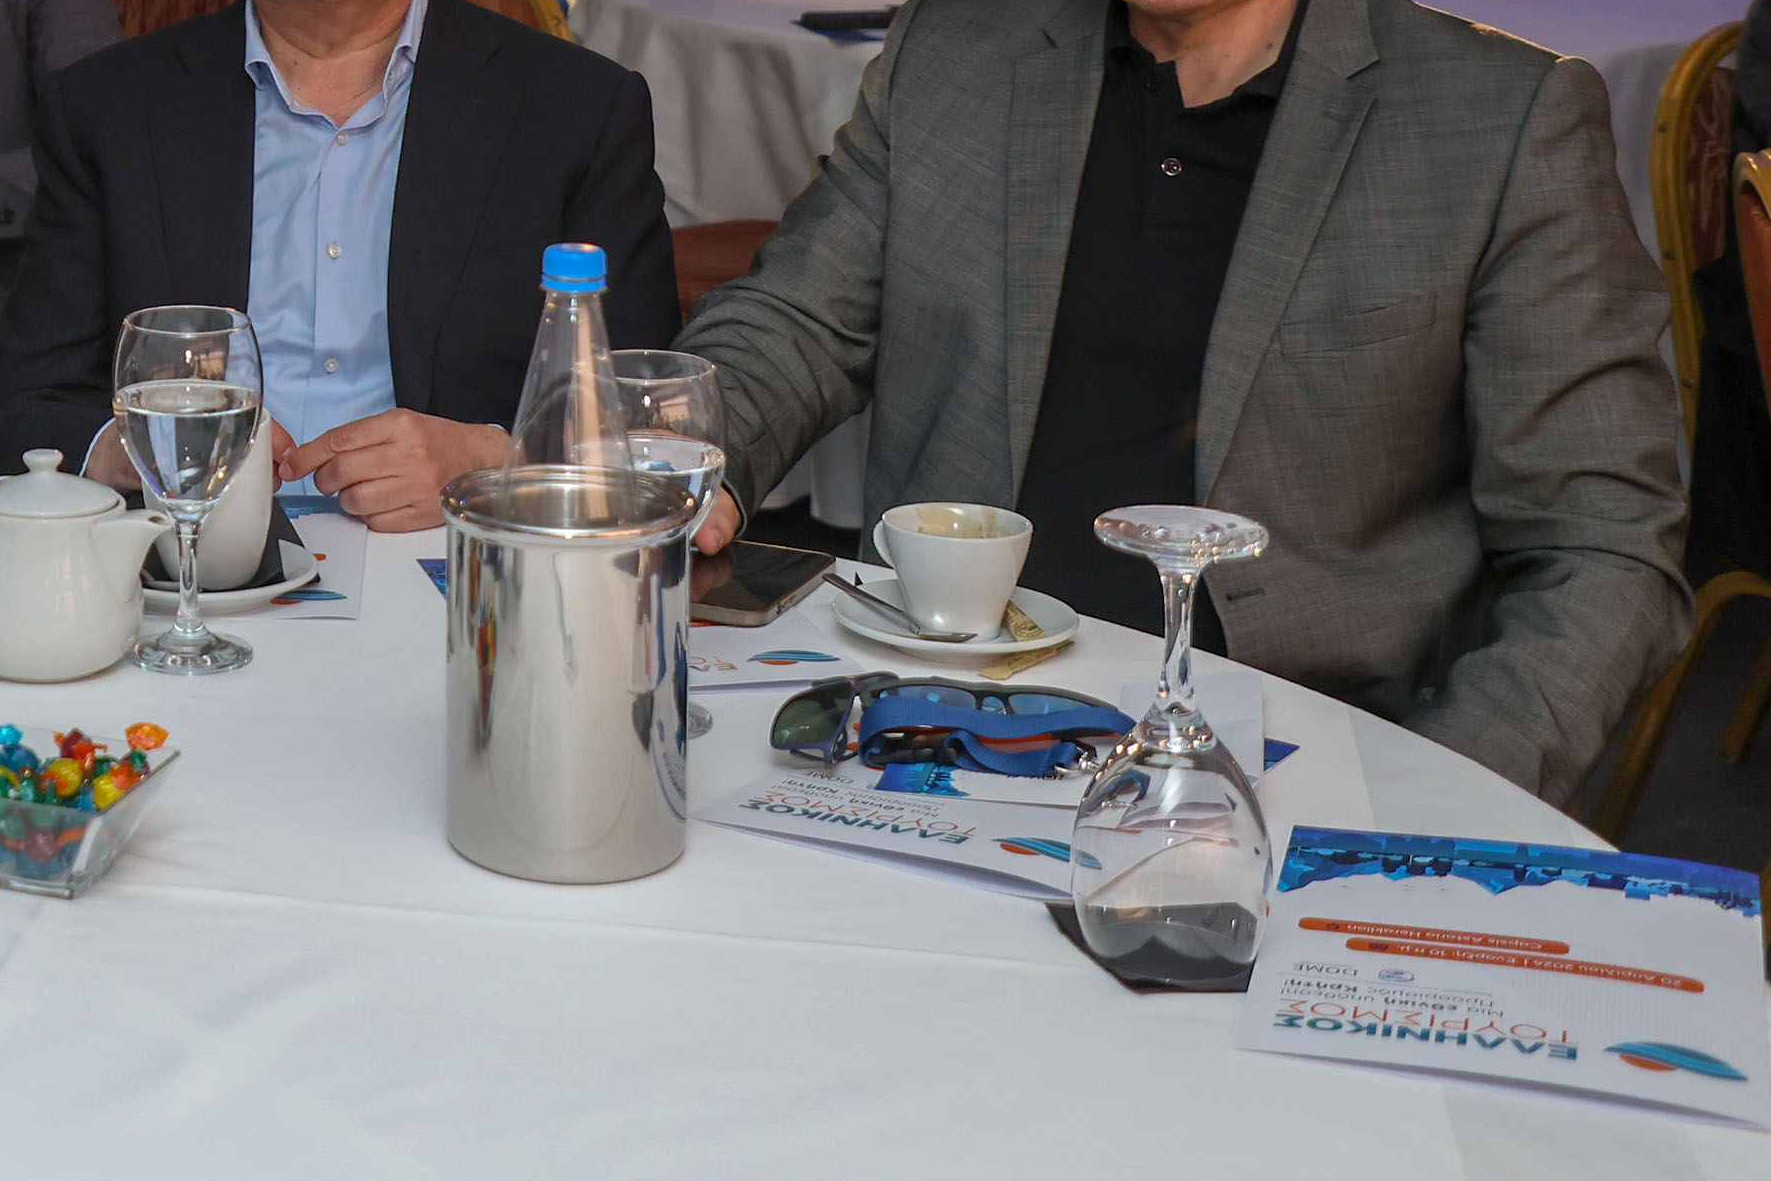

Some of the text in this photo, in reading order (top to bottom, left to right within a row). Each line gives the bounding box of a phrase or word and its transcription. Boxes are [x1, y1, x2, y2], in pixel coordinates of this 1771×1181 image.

[782, 779, 838, 794] Κρήτη!
[755, 790, 977, 837] ΤΟΥΡΙΣΜΟΣ
[849, 798, 905, 812] εθνική
[739, 799, 969, 845] ΕΛΛΗΝΙΚΟΣ
[1347, 923, 1543, 950] Capsis Astoria Heraklion
[1428, 948, 1447, 958] 10
[1533, 959, 1574, 970] 2024
[1294, 963, 1358, 976] DOME
[1660, 976, 1683, 987] 20
[1280, 987, 1504, 1018] Μια εθνική υπόθεση!
[1284, 979, 1494, 1007] Προορισμός Κρήτη!
[1278, 997, 1578, 1044] ΤΟΥΡΙΣΜΟΣ
[1273, 1013, 1577, 1060] ΕΛΛΗΝΙΚΟΣ
